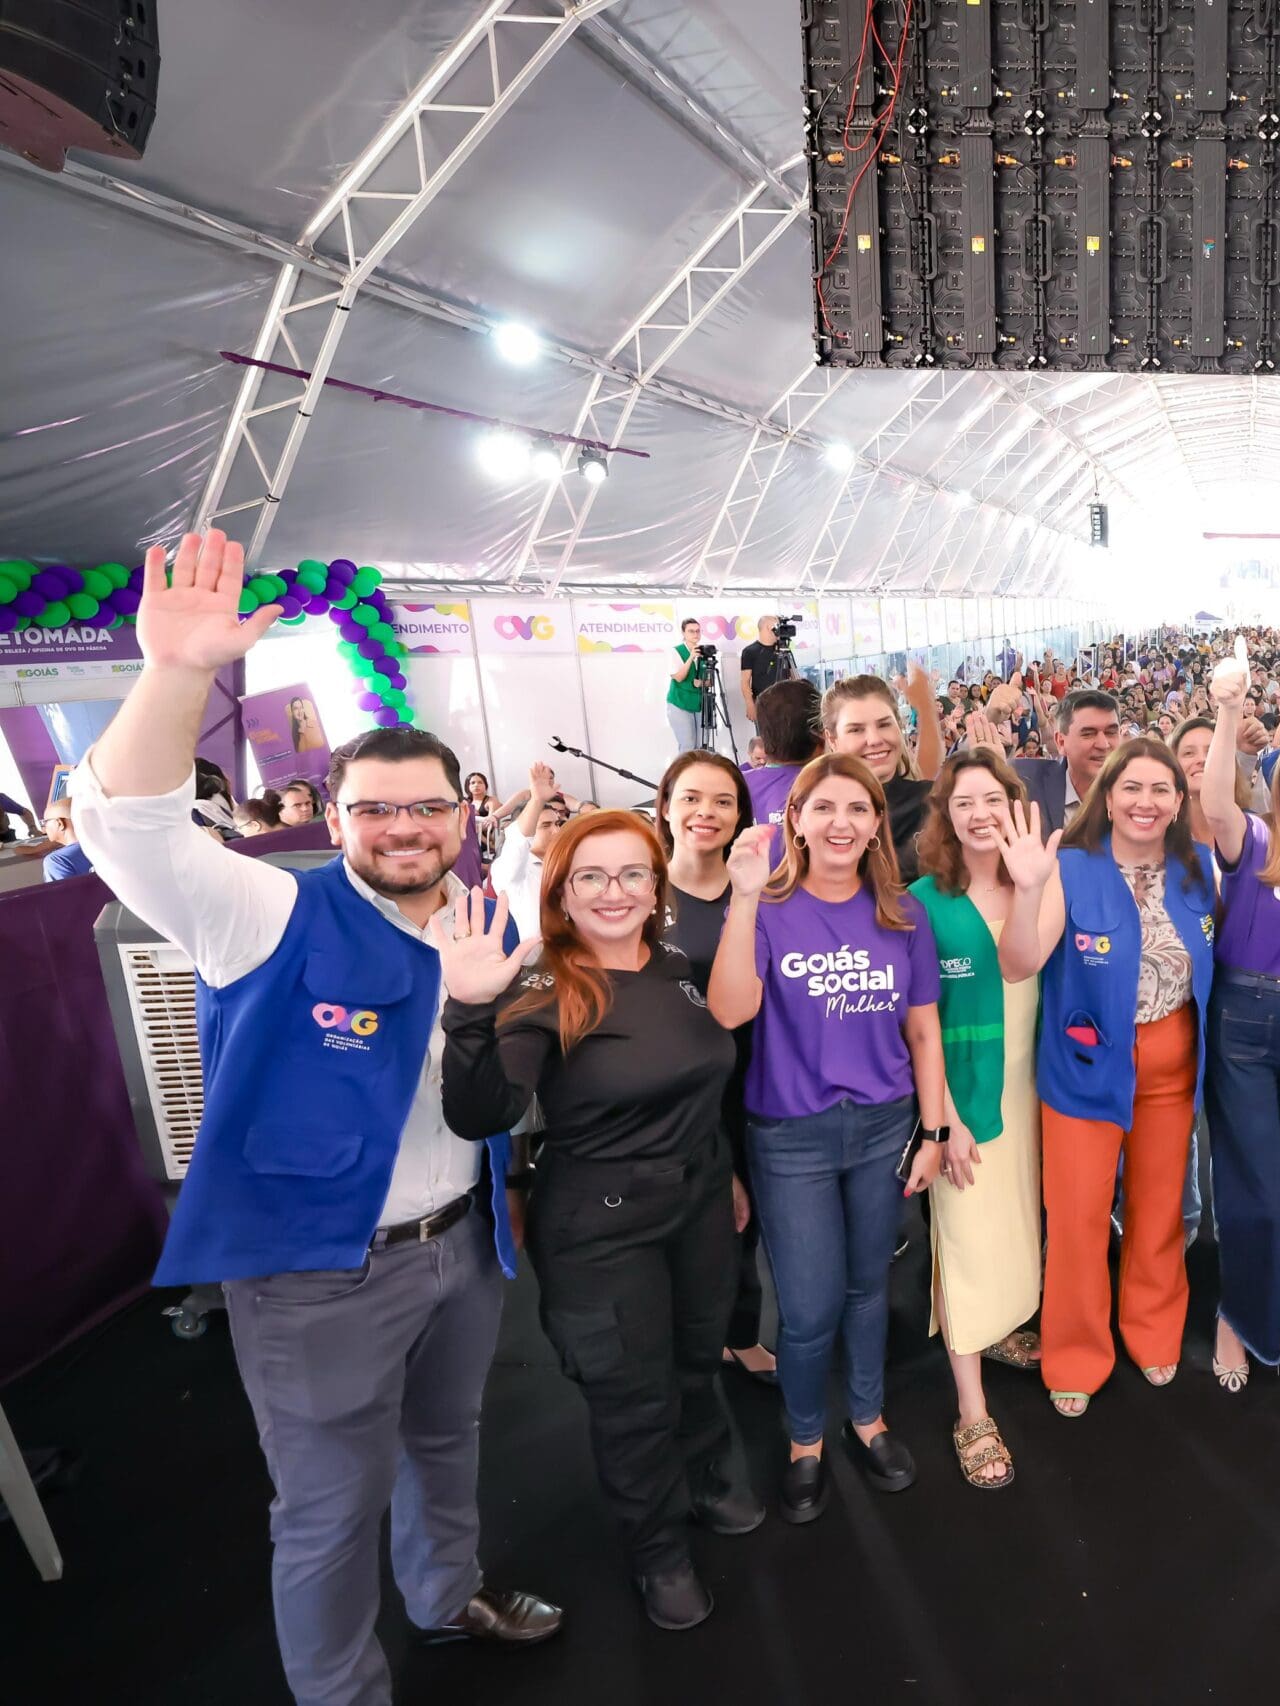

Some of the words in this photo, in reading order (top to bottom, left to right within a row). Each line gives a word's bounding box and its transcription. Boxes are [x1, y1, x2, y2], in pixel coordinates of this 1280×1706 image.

[0, 627, 114, 646] ETOMADA
[392, 624, 470, 634] ENDIMENTO
[494, 615, 555, 640] OVG
[579, 624, 674, 633] ATENDIMENTO
[25, 666, 59, 678] GOIÁS
[780, 944, 871, 978] Goiás
[808, 964, 894, 996] social
[312, 1002, 378, 1036] OVG
[826, 993, 896, 1020] Mulher
